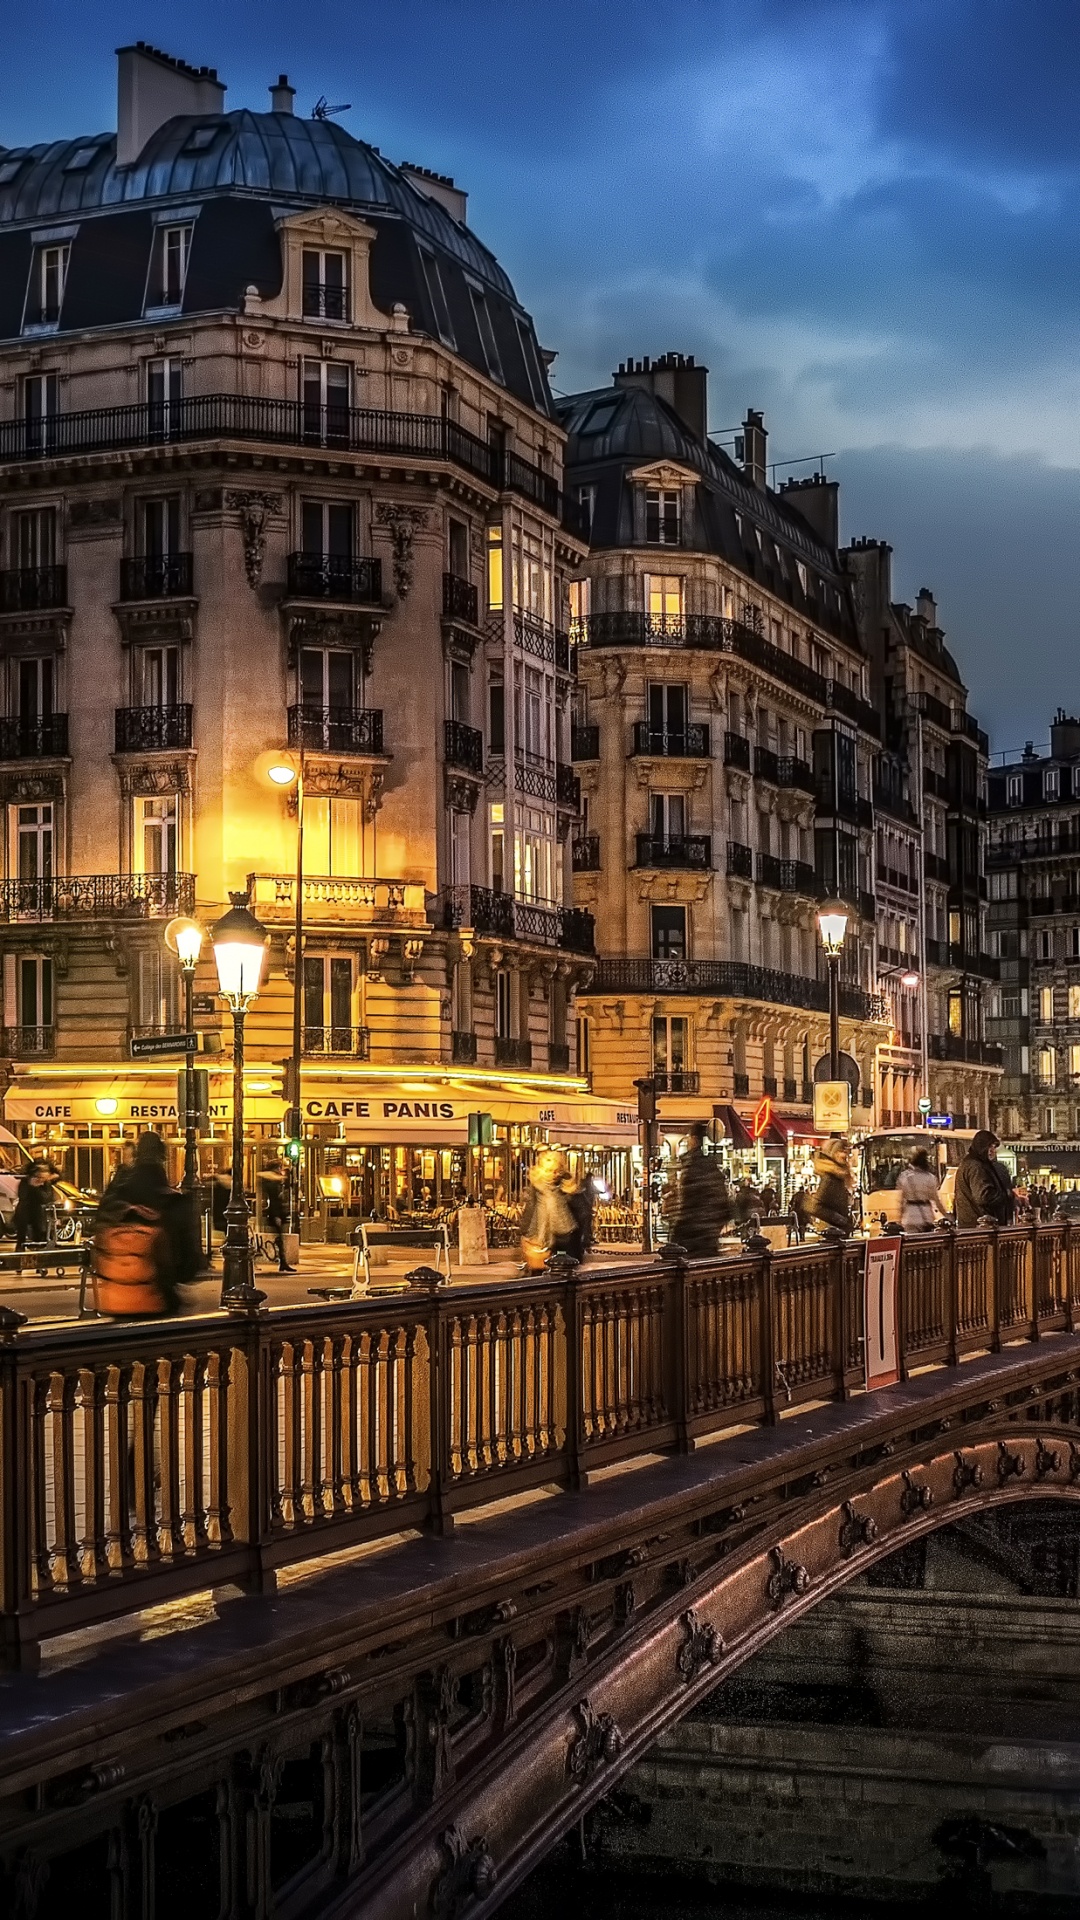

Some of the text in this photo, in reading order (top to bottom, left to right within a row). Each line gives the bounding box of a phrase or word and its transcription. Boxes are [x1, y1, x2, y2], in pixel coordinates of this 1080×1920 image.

[35, 1105, 228, 1118] CAFE RESTANT
[306, 1101, 454, 1118] CAFE PANIS
[539, 1110, 639, 1124] CAFE RESTAUR
